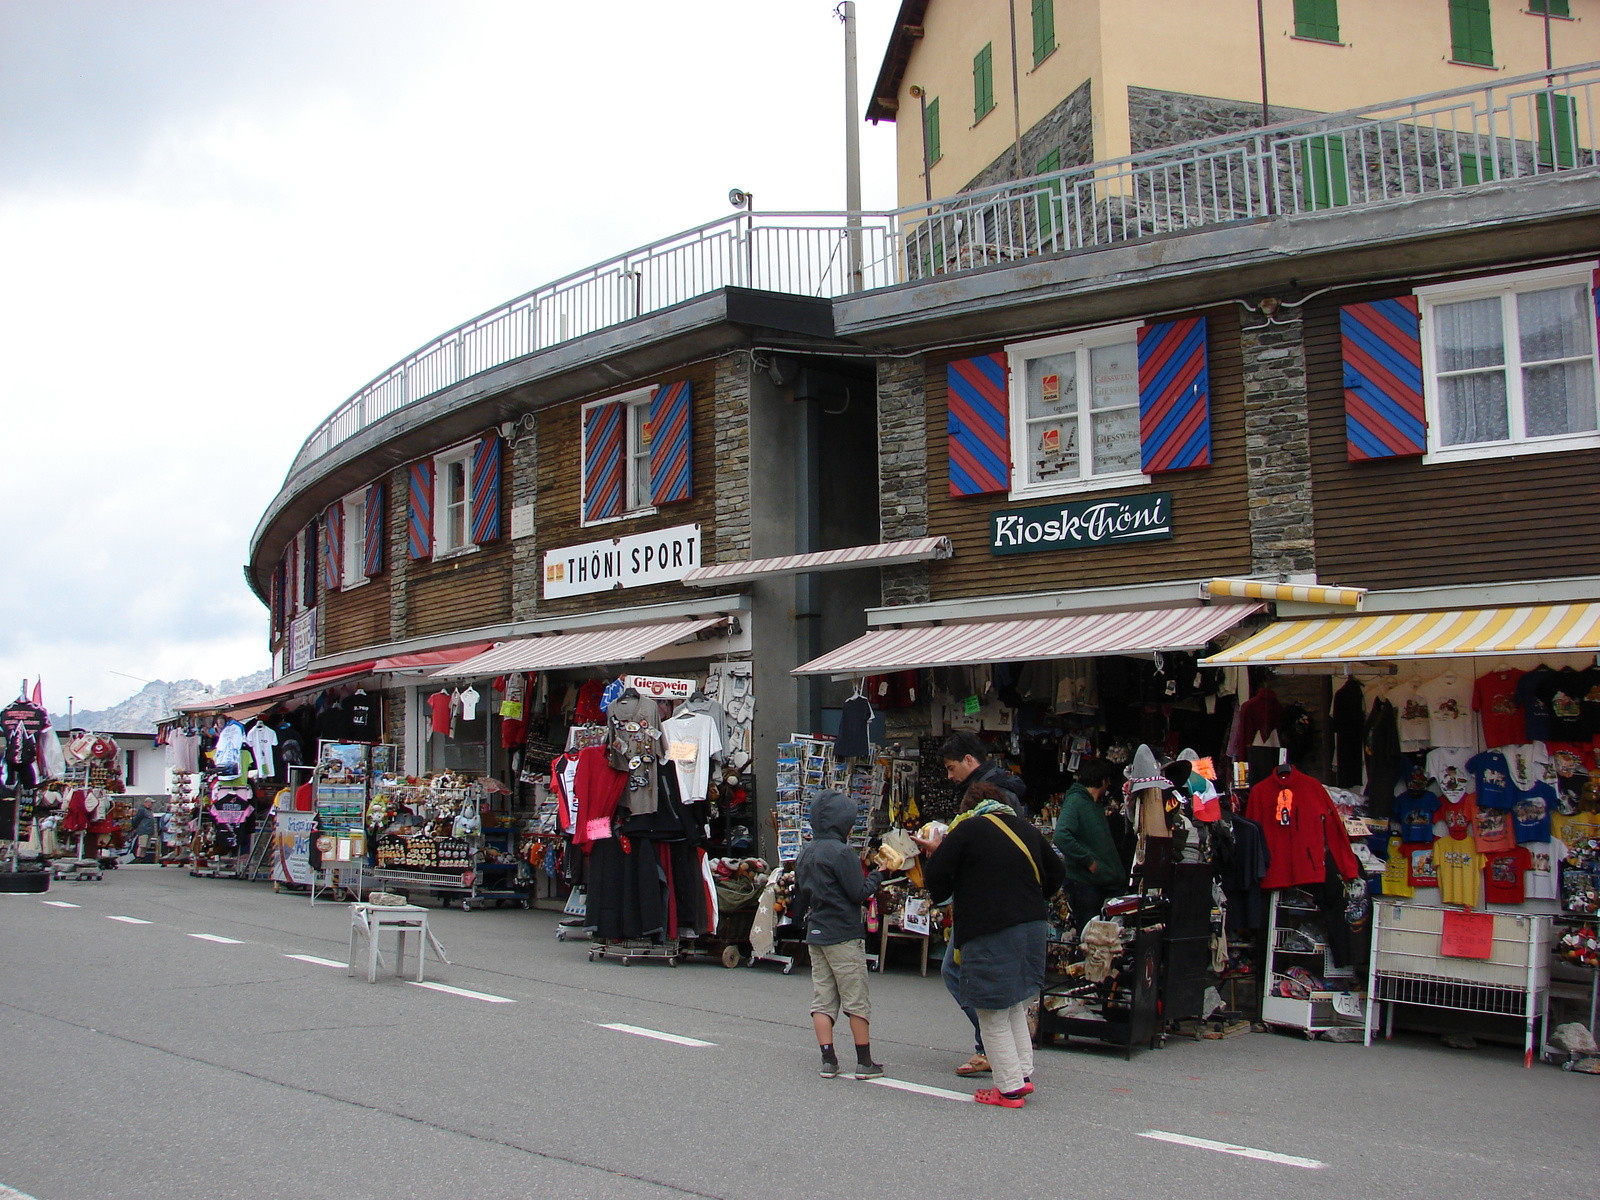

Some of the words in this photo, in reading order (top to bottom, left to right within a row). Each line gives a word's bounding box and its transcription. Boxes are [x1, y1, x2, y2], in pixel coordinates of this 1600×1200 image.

[994, 509, 1083, 546] Kiosk
[1080, 498, 1166, 541] Thöni
[568, 550, 621, 584] THÖNI
[631, 537, 695, 574] SPORT
